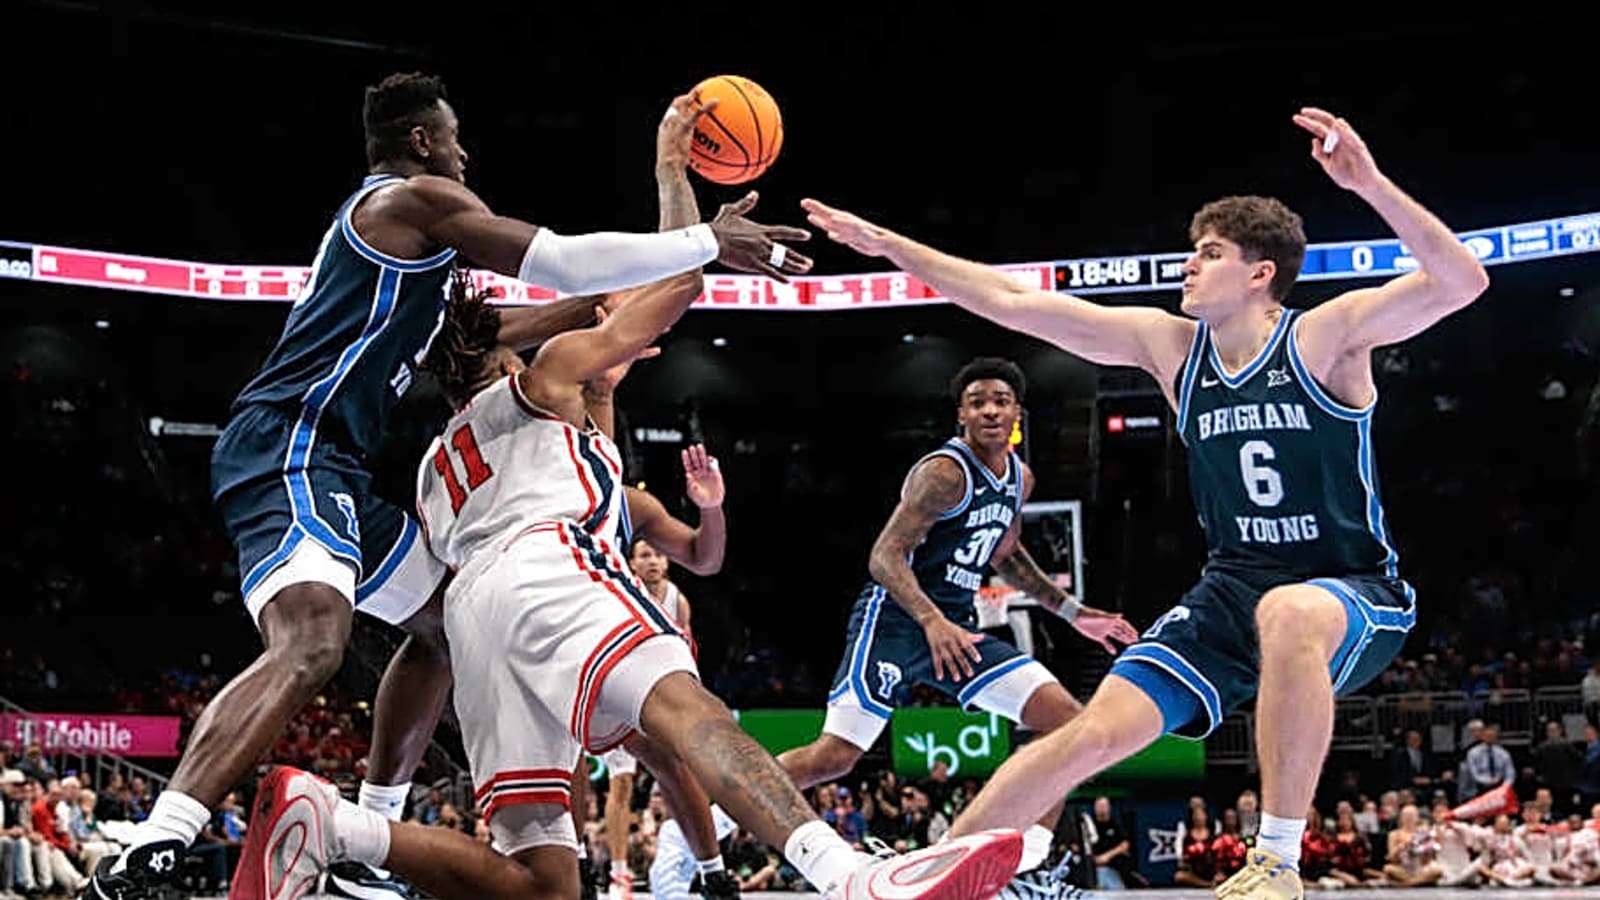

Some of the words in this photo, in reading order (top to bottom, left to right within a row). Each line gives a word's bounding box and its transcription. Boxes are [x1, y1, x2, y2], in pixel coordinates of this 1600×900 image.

[1352, 246, 1374, 272] 0
[1198, 402, 1311, 440] BRIGHAM
[434, 422, 495, 517] 11
[1239, 439, 1285, 507] 6
[1236, 515, 1320, 543] YOUNG
[45, 720, 132, 749] Mobile
